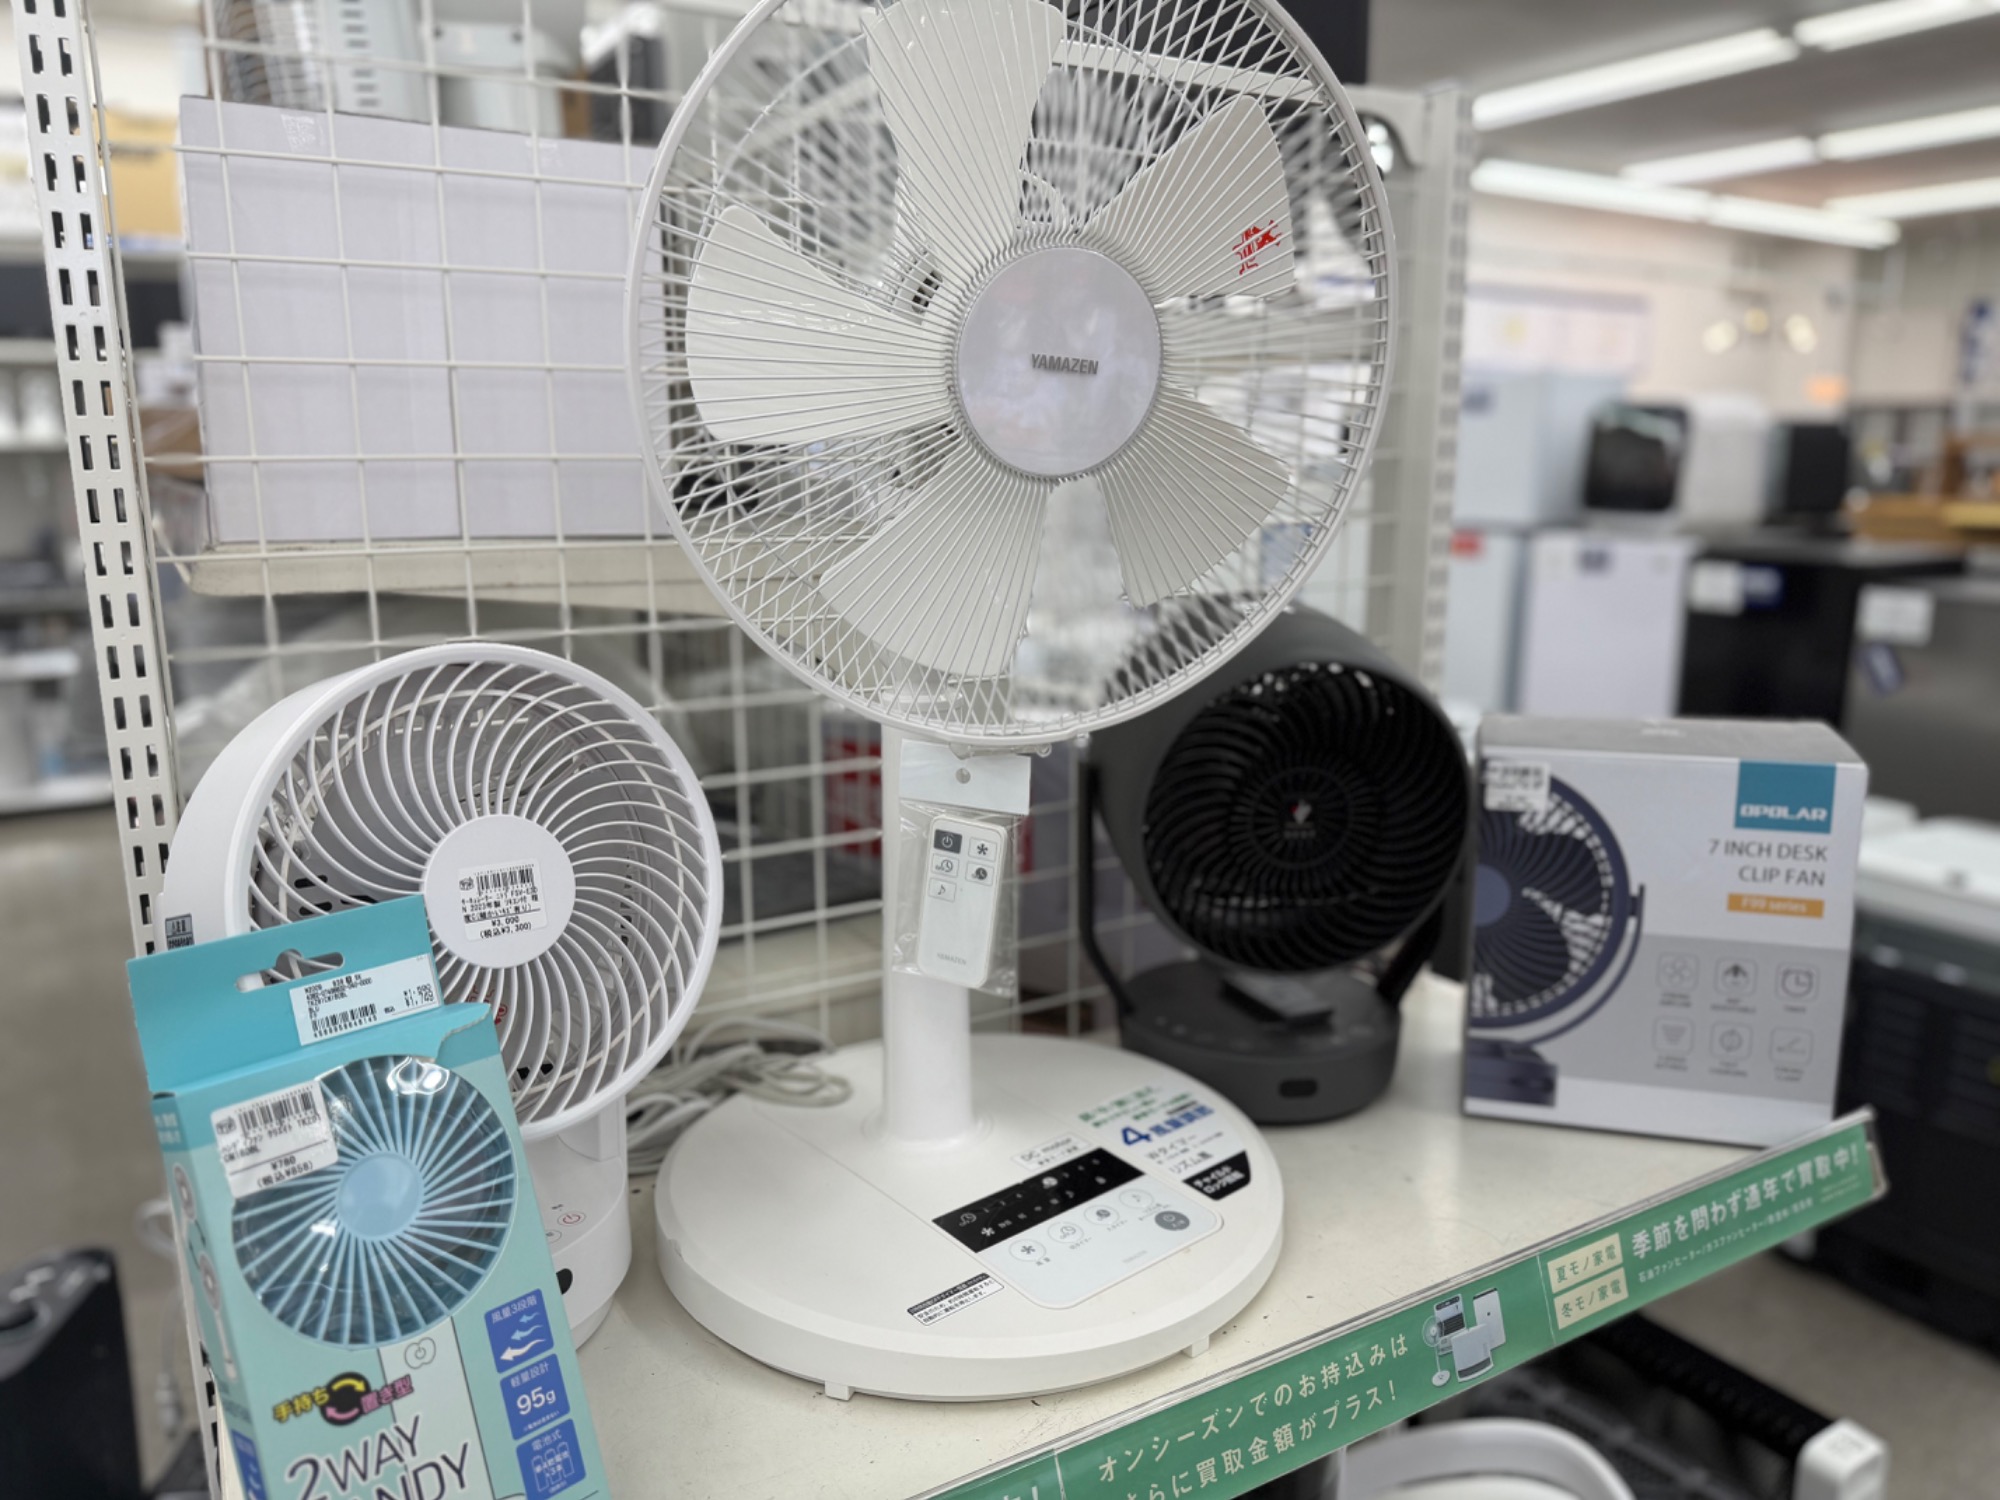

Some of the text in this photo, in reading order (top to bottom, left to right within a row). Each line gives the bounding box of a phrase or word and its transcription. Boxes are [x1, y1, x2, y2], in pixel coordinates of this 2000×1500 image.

[1031, 353, 1099, 375] YAMAZEN
[1740, 804, 1827, 820] OPOLAR
[1709, 838, 1828, 862] 7 INCH DESK
[1738, 865, 1825, 886] CLIP FAN
[271, 1155, 297, 1170] ¥780
[1555, 1244, 1617, 1283] 夏モノ家電
[491, 1294, 538, 1324] 風量3段階
[1561, 1279, 1622, 1318] 冬モノ家電
[510, 1361, 551, 1389] 軽量設計
[273, 1386, 330, 1423] 手持ち
[360, 1374, 414, 1414] 置き型
[516, 1386, 557, 1415] 95g
[1098, 1333, 1409, 1483] オンシーズンでのお持込みは
[531, 1429, 562, 1451] 電池式
[289, 1415, 419, 1500] 2WAY
